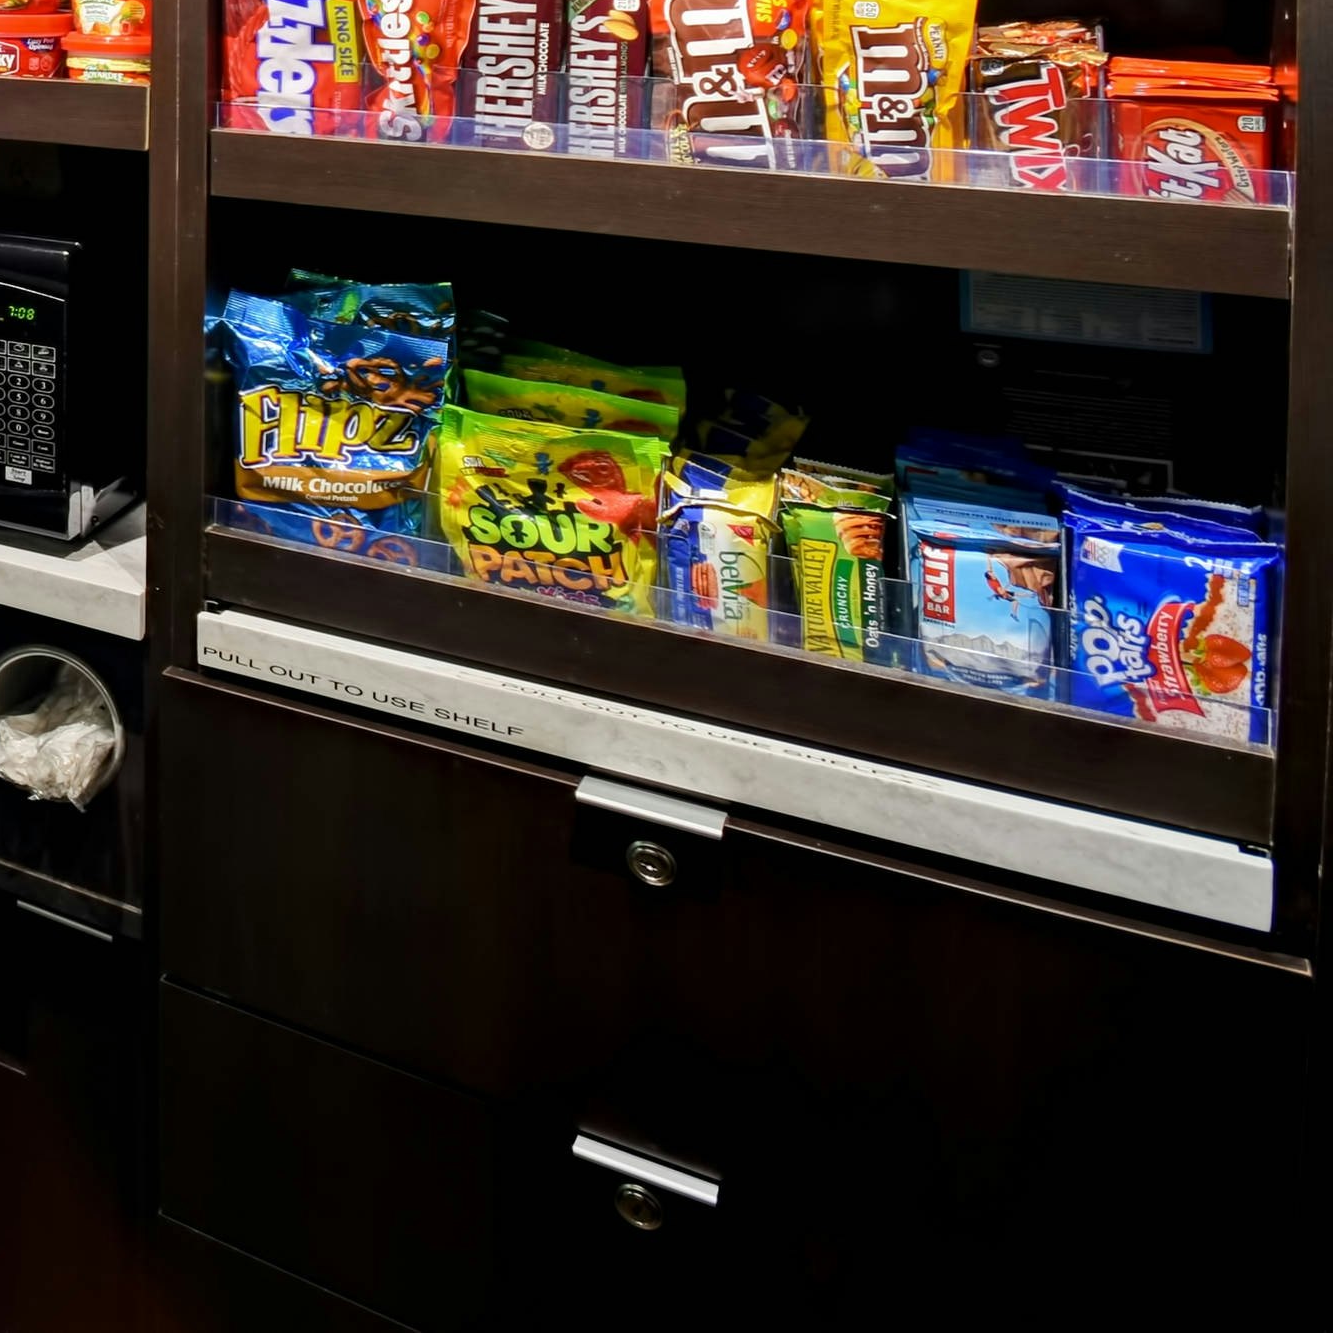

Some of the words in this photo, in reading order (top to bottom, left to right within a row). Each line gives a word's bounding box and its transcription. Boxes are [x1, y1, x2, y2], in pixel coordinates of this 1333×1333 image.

[334, 4, 354, 45] KING
[538, 22, 550, 72] CHOCOLATE
[928, 21, 945, 62] PEANUT
[339, 46, 356, 77] SIZE
[537, 72, 547, 96] MILK
[567, 14, 619, 160] HERSHEY'S
[618, 94, 628, 136] CHOCOLATE
[985, 63, 1067, 190] TWIX
[618, 136, 626, 153] MILK
[8, 305, 36, 320] 7:08
[239, 387, 420, 468] Flipz
[263, 475, 303, 493] Milk
[469, 506, 615, 555] SOUR
[469, 544, 628, 593] PATCH
[719, 550, 744, 621] belvita
[805, 542, 829, 590] VALLEY
[865, 562, 880, 603] Honey
[927, 544, 950, 601] CLIF
[837, 575, 849, 630] CRUNCHY
[927, 600, 950, 617] BAR
[865, 618, 881, 650] Oats
[1157, 610, 1180, 696] Strawberry
[202, 645, 263, 671] PULL
[268, 665, 323, 686] OUT
[328, 679, 365, 697] TO
[371, 690, 426, 714] USE
[433, 706, 525, 737] SHELF
